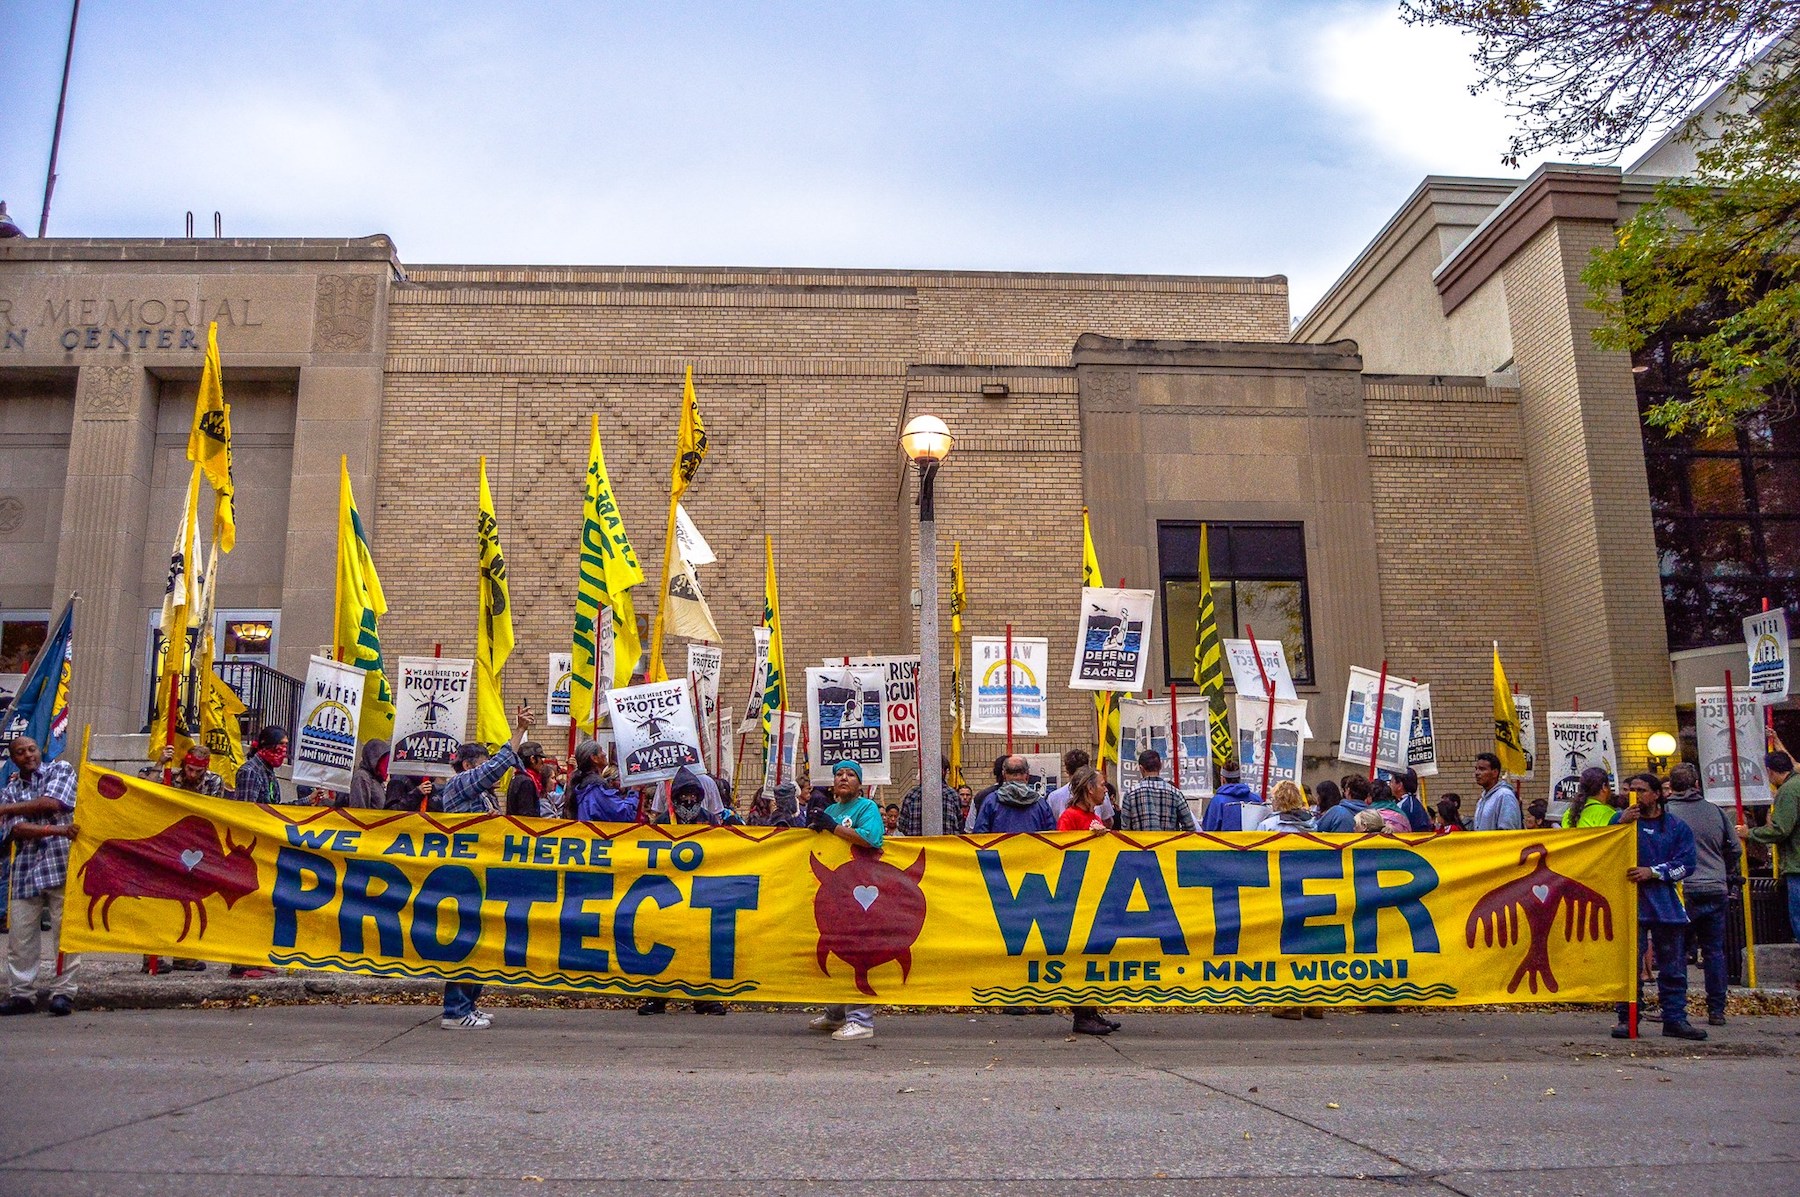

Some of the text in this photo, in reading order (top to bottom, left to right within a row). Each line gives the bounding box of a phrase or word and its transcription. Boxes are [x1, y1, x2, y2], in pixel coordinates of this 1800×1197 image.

[40, 299, 263, 327] MEMORIAL
[60, 328, 199, 350] CENTER
[692, 656, 719, 670] PROTECT
[1085, 650, 1136, 662] DEFEND
[1082, 667, 1134, 678] SACRED
[405, 676, 467, 692] PROTECT
[315, 680, 357, 706] WATER
[617, 693, 682, 713] PROTECT
[316, 712, 346, 732] LIFE
[822, 728, 879, 741] DEFEND
[1554, 730, 1598, 743] PROTECT
[405, 737, 458, 752] WATER
[424, 750, 443, 758] LIFE
[635, 745, 691, 763] WATER
[659, 757, 677, 766] LIFE
[823, 748, 880, 761] SACRED
[285, 824, 703, 871] WE ARE HERE TO
[976, 849, 1440, 956] WATER
[272, 847, 760, 979] PROTECT
[1028, 959, 1408, 983] IS LIFE MNI WICONI
